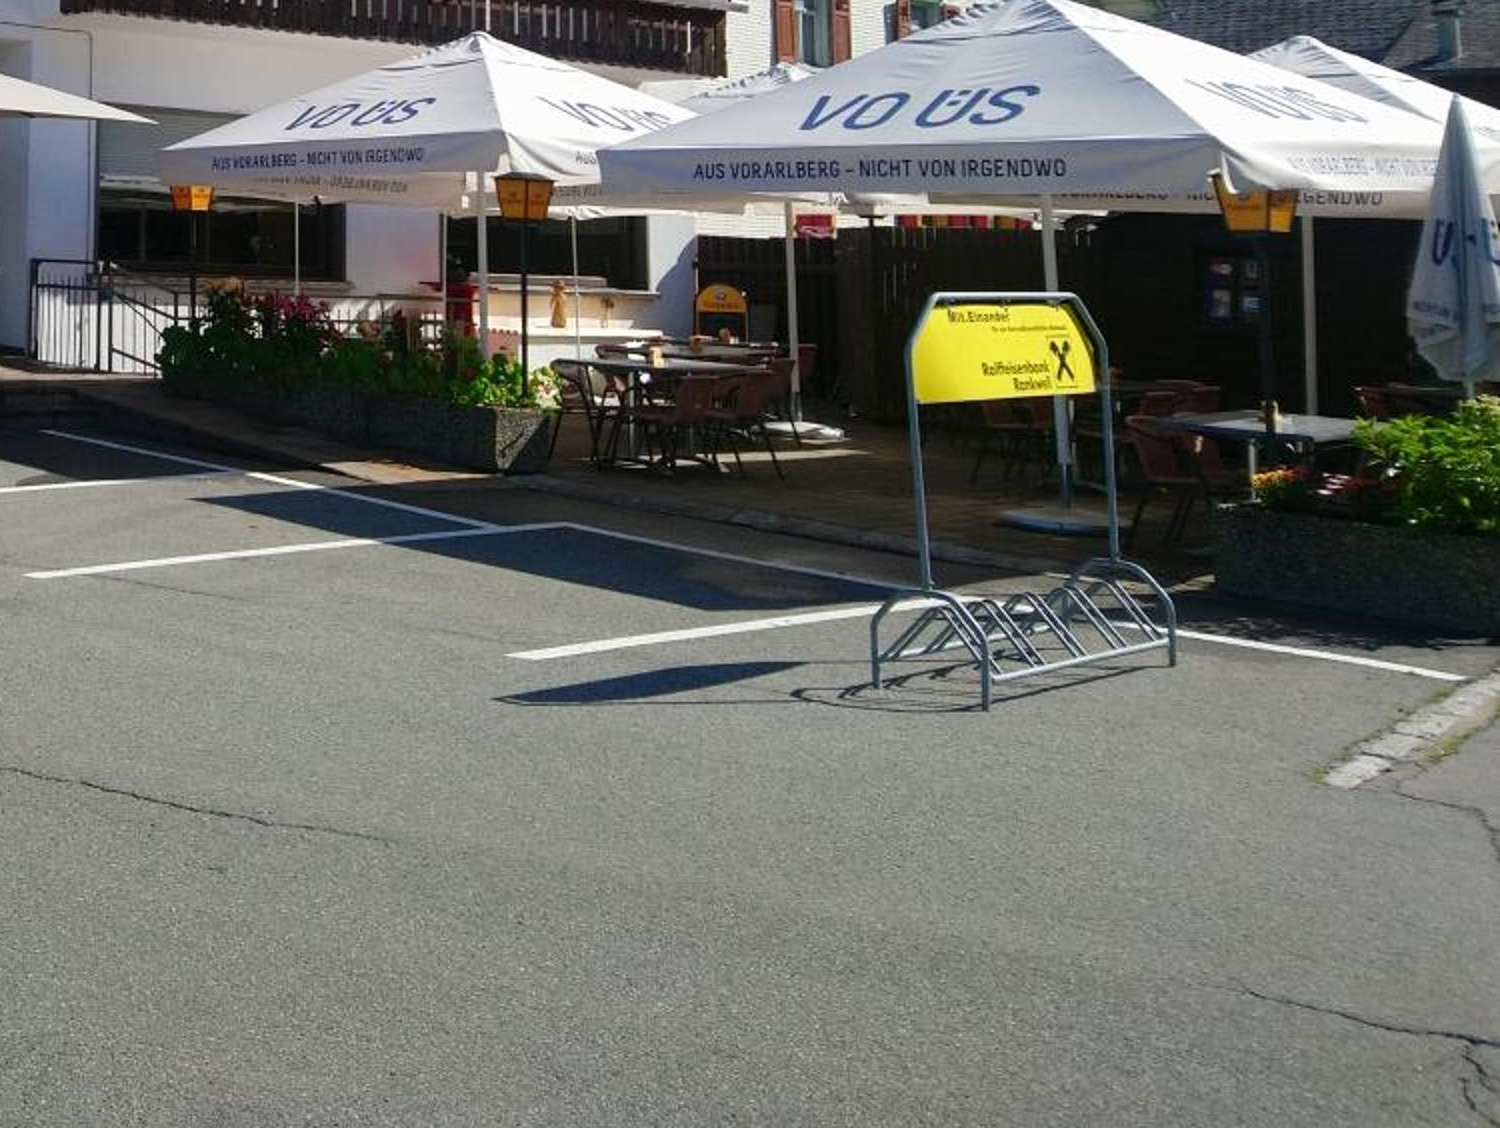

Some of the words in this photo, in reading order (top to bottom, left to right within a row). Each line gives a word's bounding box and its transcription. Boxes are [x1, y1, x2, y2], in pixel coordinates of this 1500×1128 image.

[799, 92, 911, 130] VO
[233, 152, 298, 170] VORARLBERG
[306, 151, 337, 167] NICHT
[338, 149, 363, 166] VON
[364, 147, 425, 164] IRGENDWO
[693, 162, 725, 180] AUS
[729, 159, 841, 179] VORARLBERG
[858, 158, 913, 178] NICHT
[917, 158, 956, 177] VON
[961, 157, 1068, 177] IRGENDWO
[981, 360, 1050, 377] Raiffeisenbank
[1012, 376, 1053, 391] Rankweil
